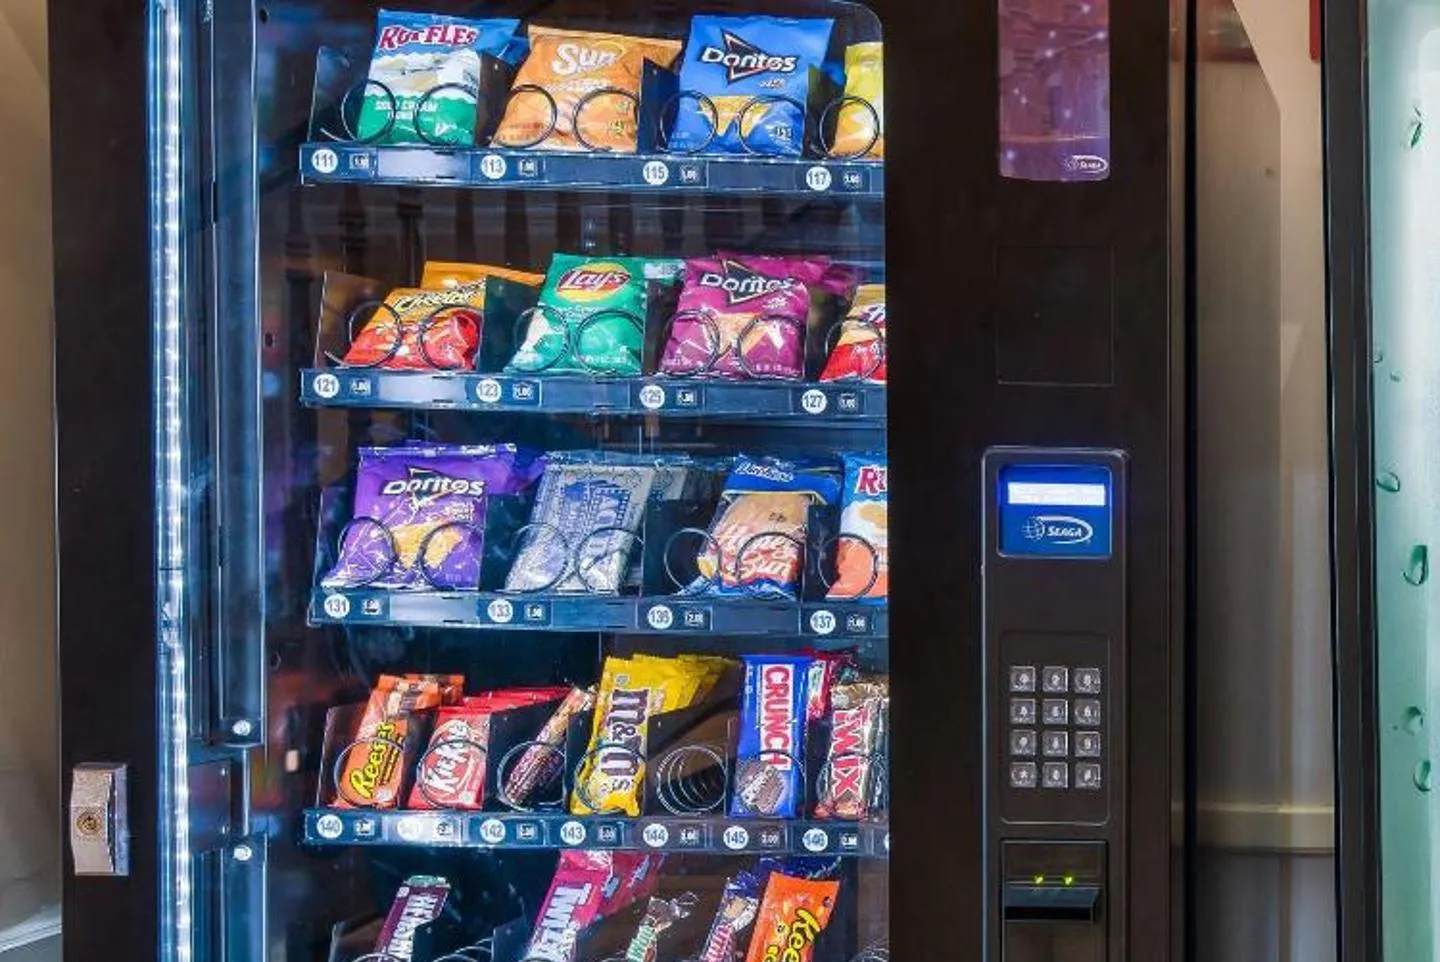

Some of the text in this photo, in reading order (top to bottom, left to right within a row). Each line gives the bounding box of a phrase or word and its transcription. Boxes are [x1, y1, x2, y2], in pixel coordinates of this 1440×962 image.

[701, 46, 797, 73] Doritos
[315, 154, 334, 168] 111
[484, 159, 502, 173] 113
[646, 165, 665, 179] 115
[808, 172, 827, 185] 117
[701, 272, 796, 294] Doritos
[317, 378, 335, 392] 121
[480, 382, 498, 397] 123
[804, 394, 823, 408] 127
[383, 476, 485, 496] Doritos
[327, 599, 346, 612] 131
[813, 615, 831, 628] 137
[764, 666, 791, 765] CRUNCH
[484, 824, 503, 837] 142
[564, 827, 583, 840] 143
[646, 829, 665, 842] 144
[726, 831, 745, 844] 145
